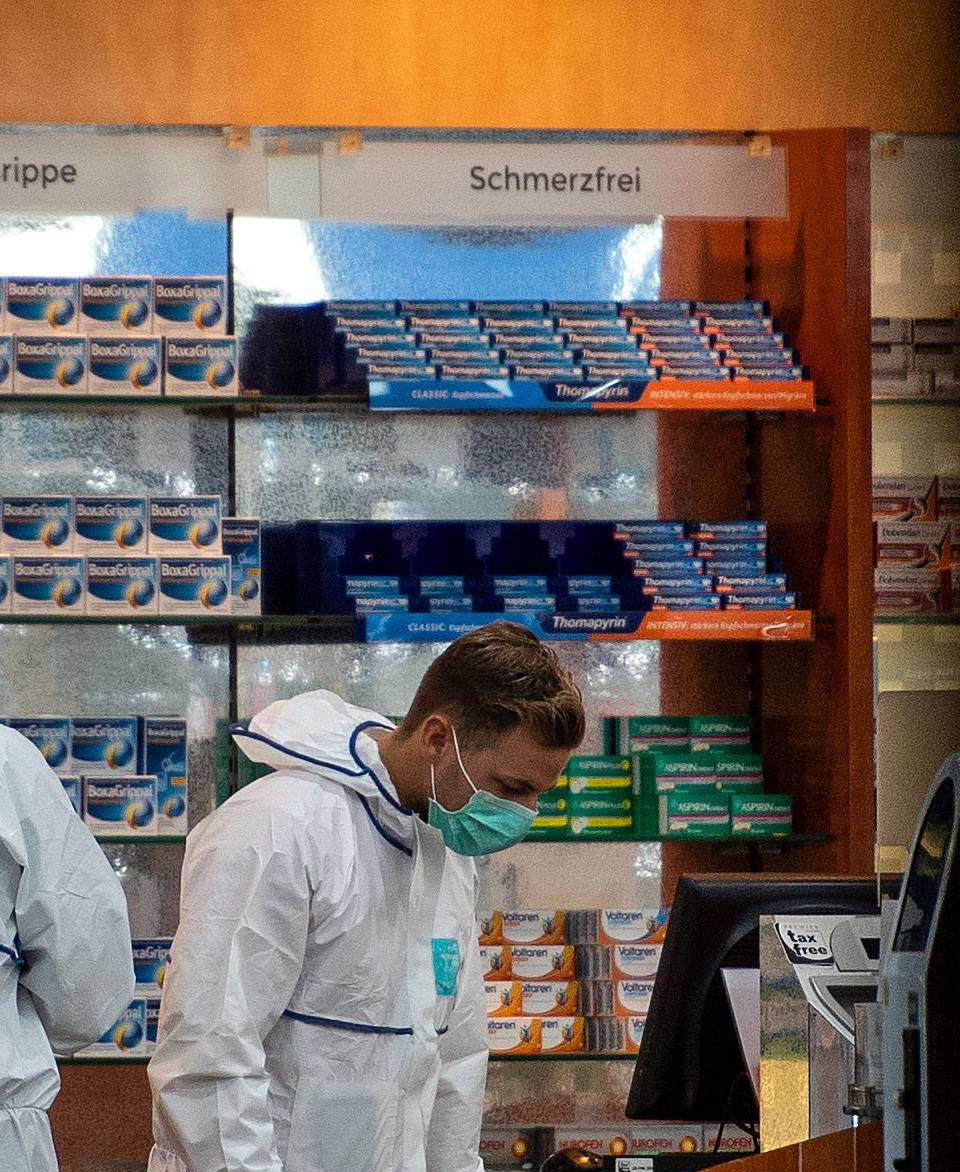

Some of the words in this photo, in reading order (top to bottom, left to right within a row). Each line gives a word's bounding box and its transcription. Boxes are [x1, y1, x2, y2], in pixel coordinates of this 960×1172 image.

[469, 165, 642, 194] Schmerzfrei
[552, 615, 627, 631] Thomapyrin
[605, 911, 643, 920] Voltaren
[787, 929, 817, 943] tax
[619, 946, 656, 956] Voltaren
[794, 943, 828, 956] free
